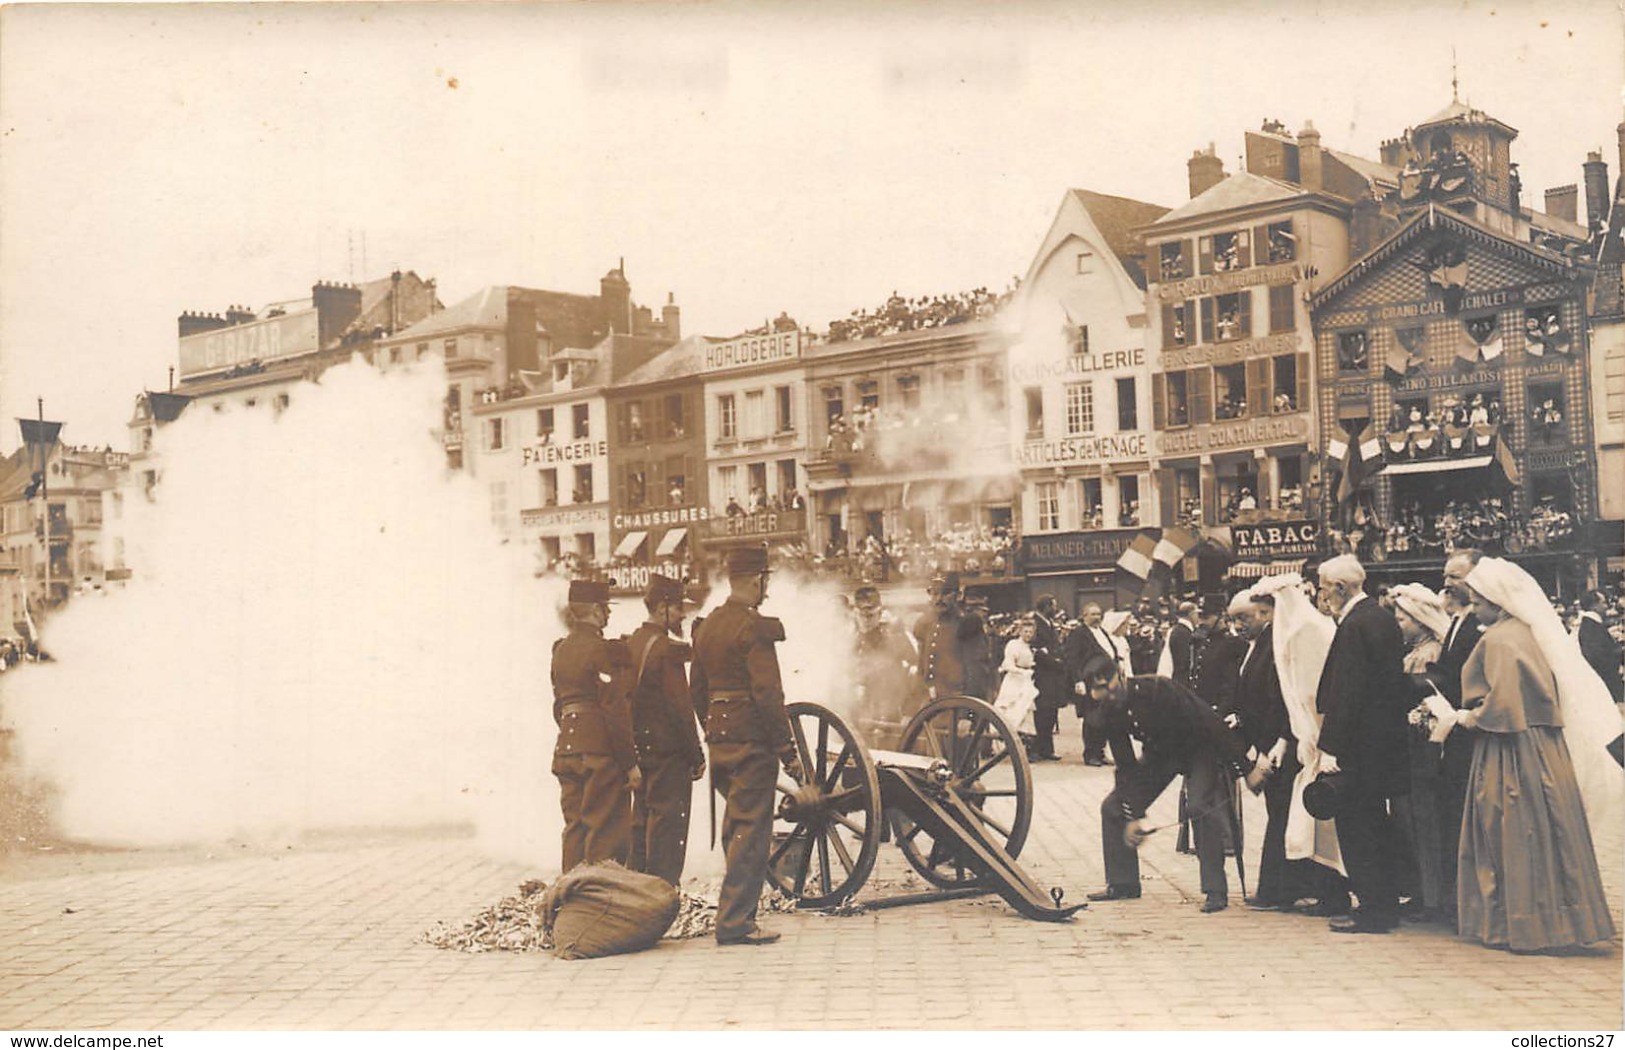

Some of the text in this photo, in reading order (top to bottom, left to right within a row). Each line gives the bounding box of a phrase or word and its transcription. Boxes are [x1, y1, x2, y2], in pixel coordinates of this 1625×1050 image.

[1382, 303, 1418, 320] GRAND
[1465, 292, 1507, 310] CHALET
[706, 334, 793, 368] HORLOGERIE
[1011, 347, 1145, 382] QUINCAILLERIE
[1428, 370, 1497, 388] BILLARDS
[1016, 440, 1077, 466] ARTICLES
[1092, 433, 1147, 461] MENAGE
[1163, 419, 1299, 453] HOTEL CONTINENTAL
[614, 507, 708, 529] CHAUSSURES
[1235, 525, 1314, 546] TABAC
